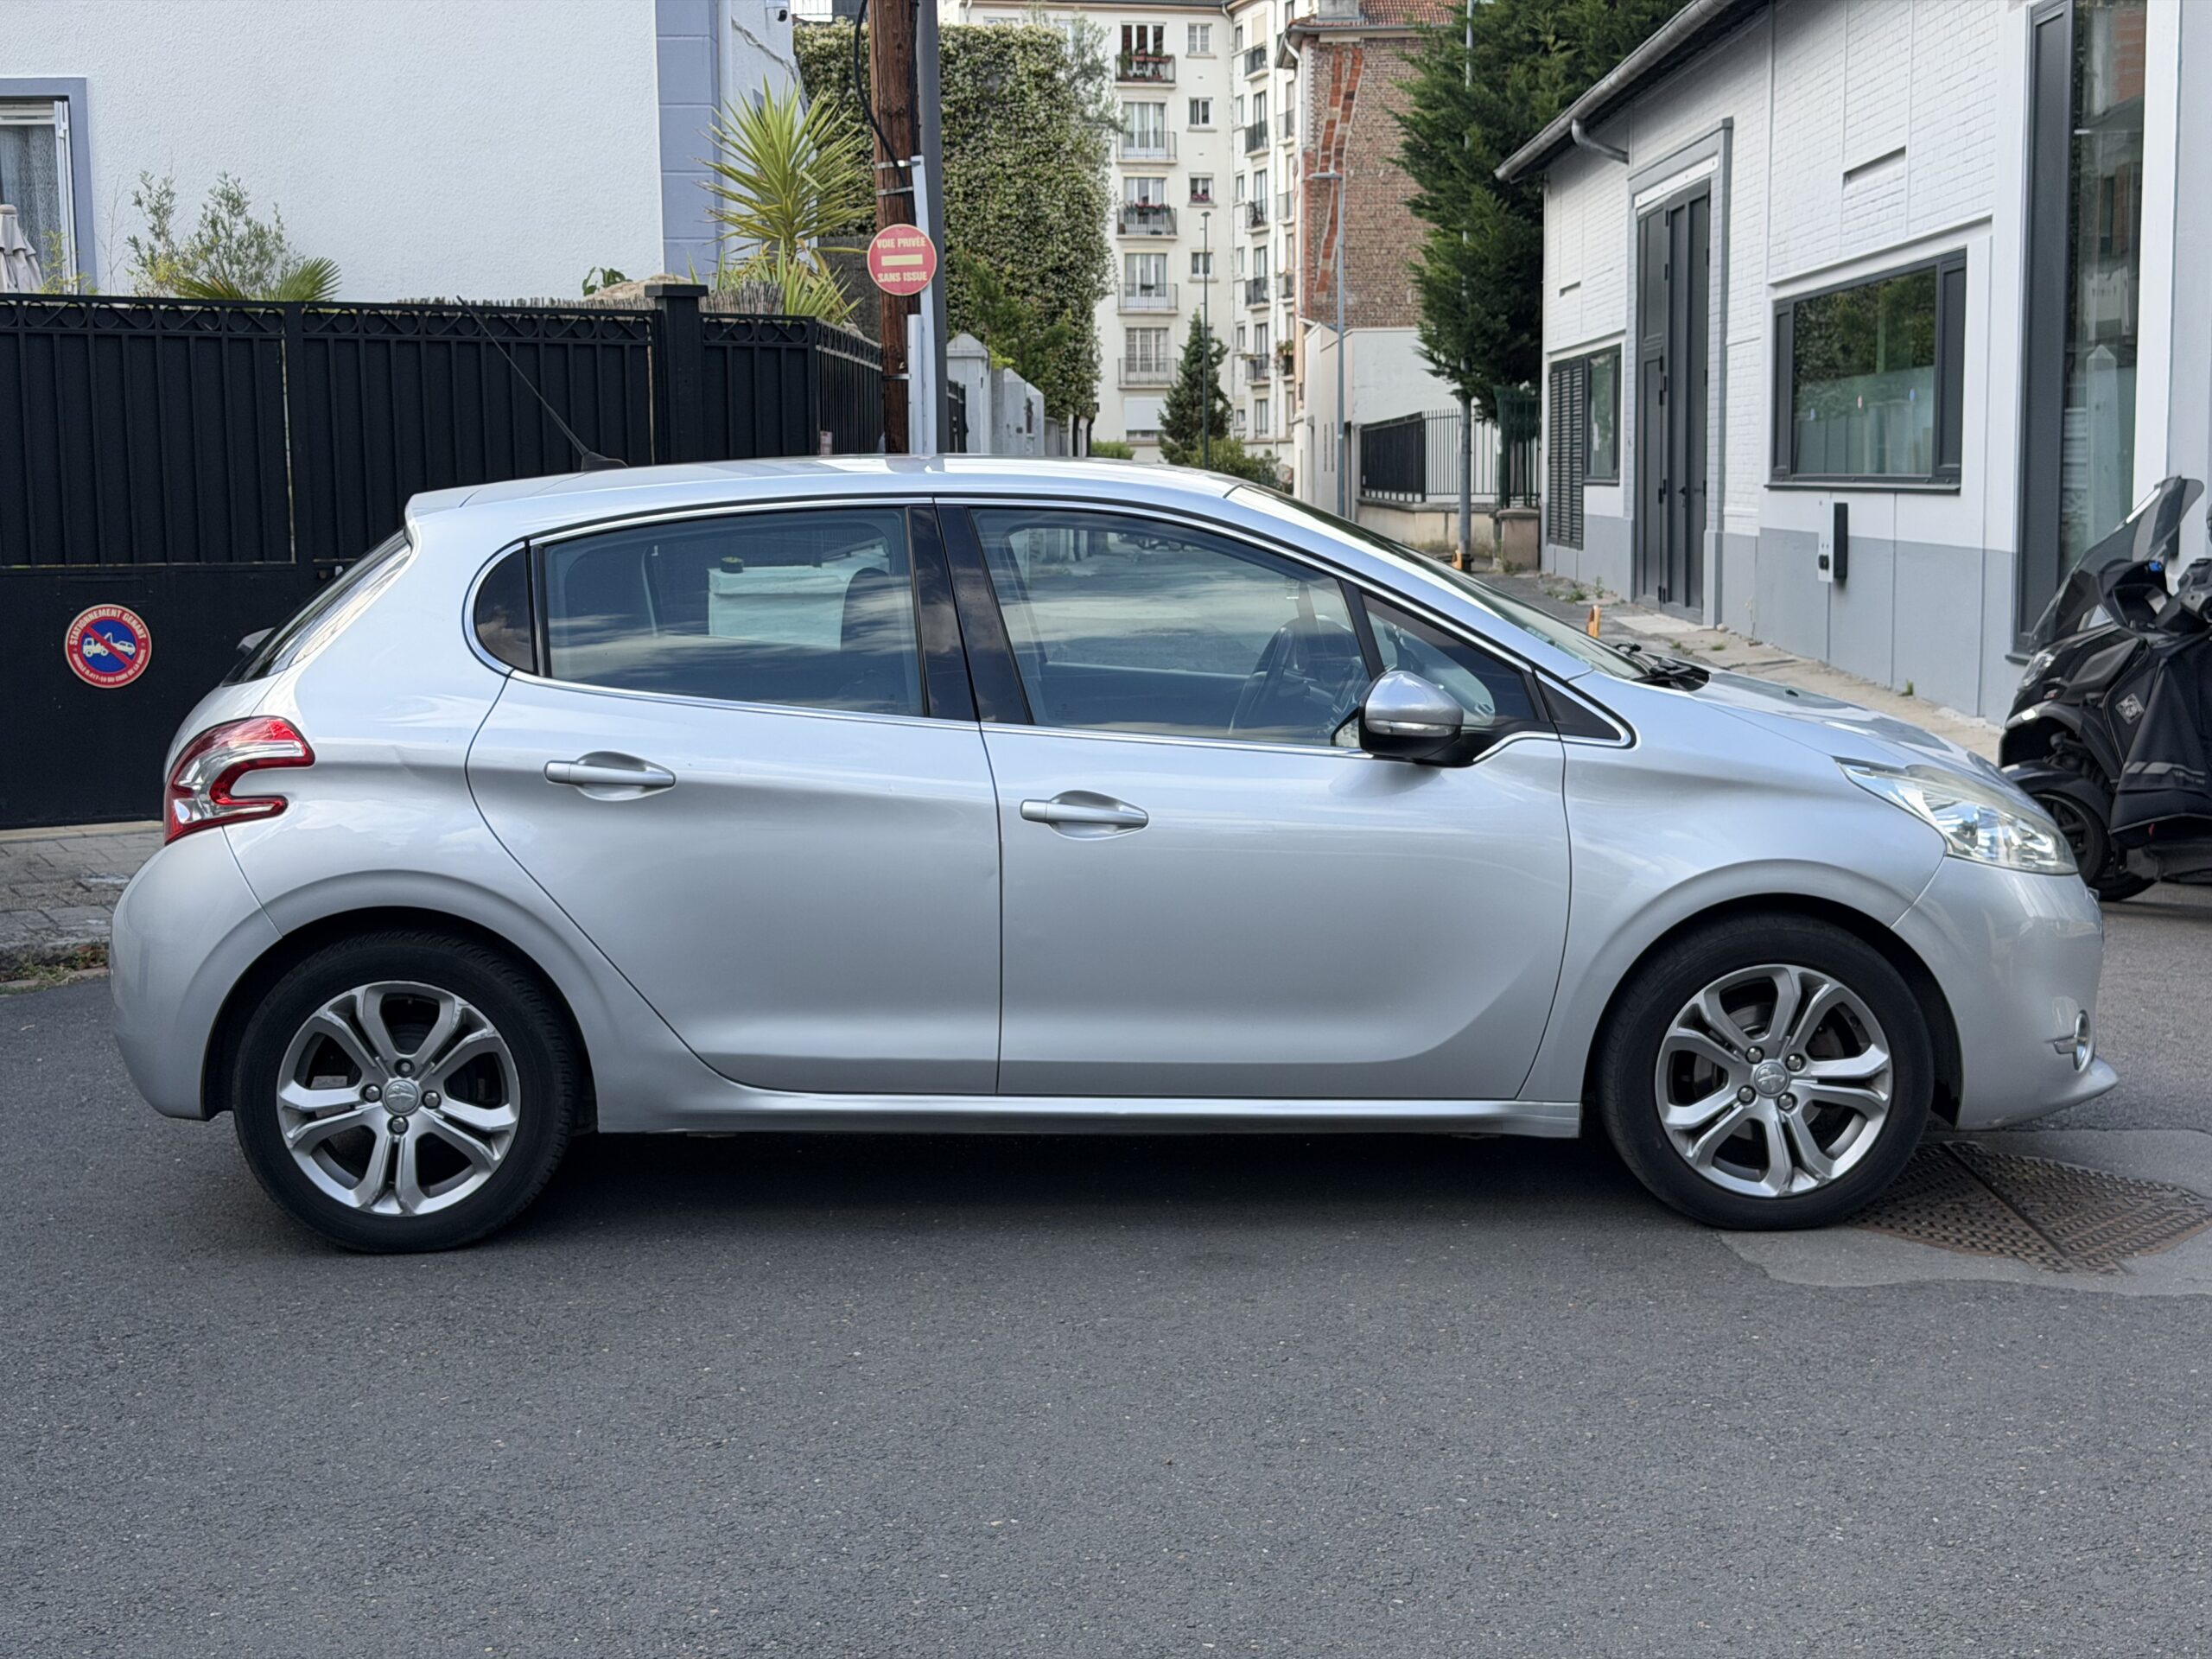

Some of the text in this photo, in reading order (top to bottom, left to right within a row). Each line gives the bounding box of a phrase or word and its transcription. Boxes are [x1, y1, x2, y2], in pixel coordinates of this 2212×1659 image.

[876, 236, 926, 249] VOIE PRIVÉE
[878, 271, 927, 283] SANS ISSUE
[70, 609, 122, 645] STATIONNEMENT
